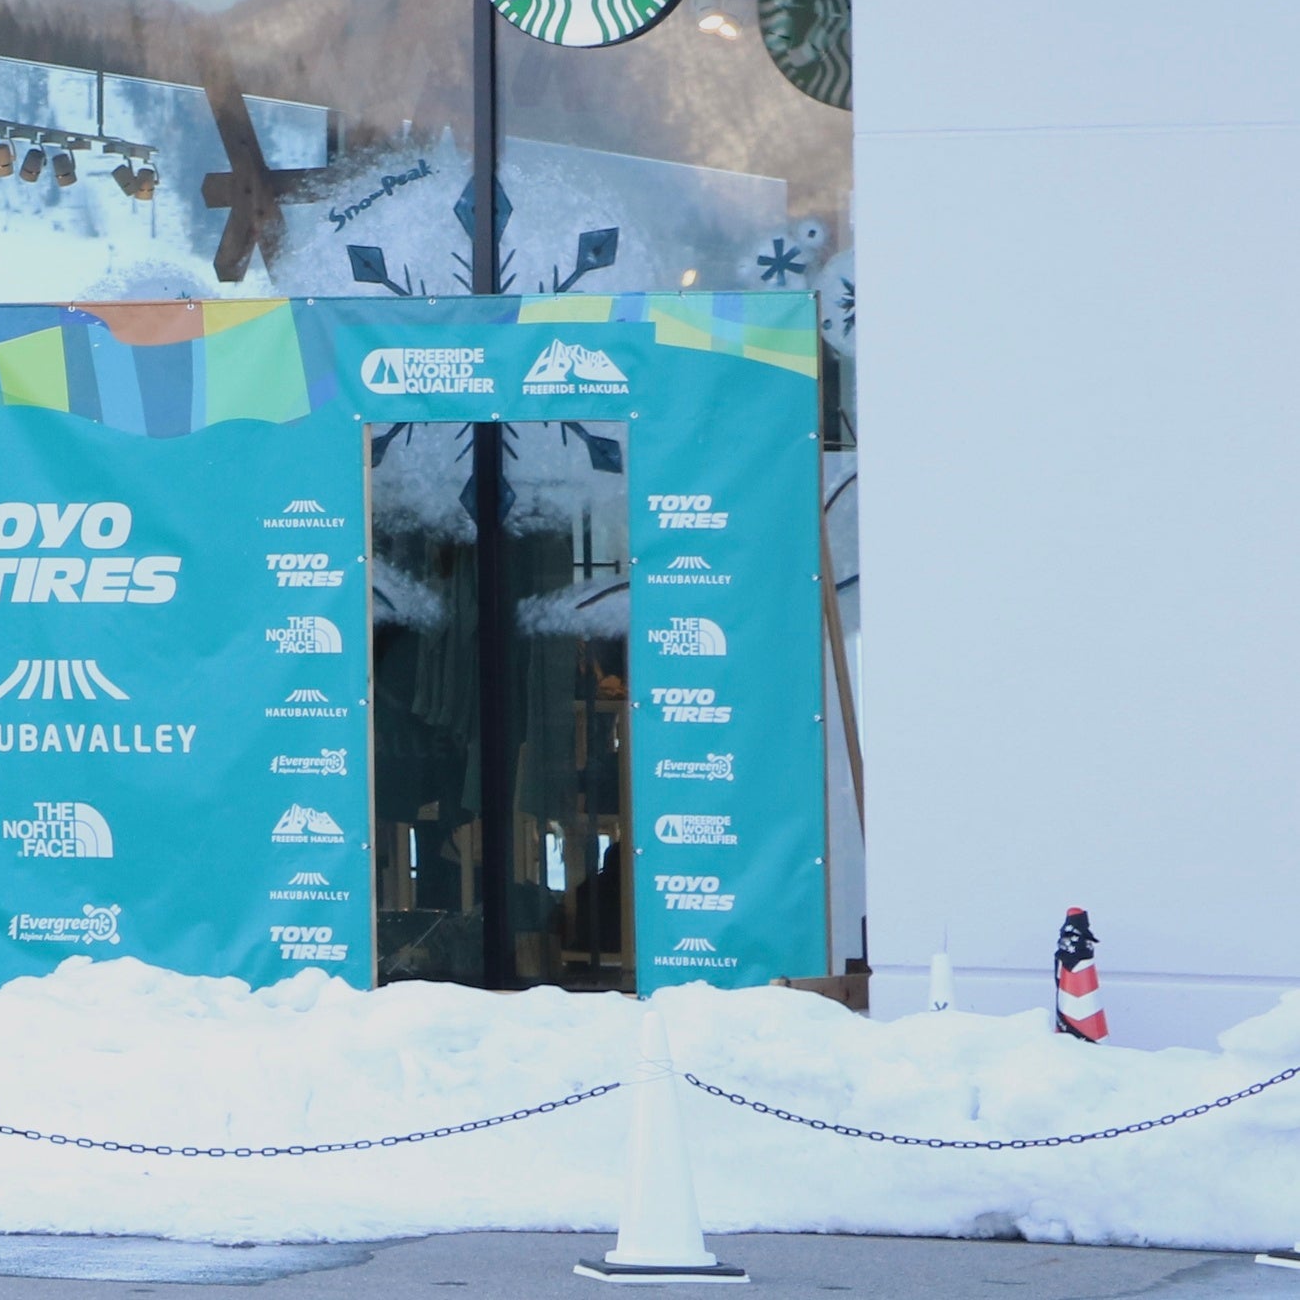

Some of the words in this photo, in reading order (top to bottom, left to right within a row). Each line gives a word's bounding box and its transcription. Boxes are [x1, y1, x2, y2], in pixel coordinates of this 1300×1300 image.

[403, 348, 484, 364] FREERIDE
[405, 365, 473, 378] WORLD
[405, 379, 494, 393] QUALIFIER
[523, 384, 574, 394] FREERIDE
[579, 384, 629, 394] HAKUBA
[648, 495, 712, 511] TOYO
[264, 518, 344, 527] HAKUBAVALLEY
[659, 512, 728, 528] TIRES
[266, 554, 328, 570] TOYO
[277, 571, 344, 586] TIRES
[648, 575, 731, 584] HAKUBAVALLEY
[288, 616, 315, 629] THE
[670, 617, 699, 630] THE
[266, 629, 315, 642] NORTH
[648, 630, 700, 643] NORTH
[652, 688, 715, 705] TOYO
[265, 708, 347, 717] HAKUBAVALLEY
[662, 706, 731, 723] TIRES
[279, 755, 333, 768] Evergreen
[664, 759, 719, 773] Evergreen
[33, 802, 75, 821] THE
[684, 816, 730, 825] FREERIDE
[2, 820, 74, 839] NORTH
[684, 825, 724, 835] WORLD
[272, 835, 308, 843] FREERIDE
[684, 834, 737, 844] QUALIFIER
[23, 838, 75, 858] FACE
[655, 875, 719, 893] TOYO
[270, 891, 349, 900] HAKUBAVALLEY
[665, 894, 735, 911] TIRES
[19, 913, 100, 934] Evergreen
[19, 932, 43, 942] Alpine
[44, 932, 80, 943] Academy
[270, 926, 332, 943] TOYO
[280, 944, 348, 960] TIRES
[654, 956, 737, 967] HAKUBAVALLEY
